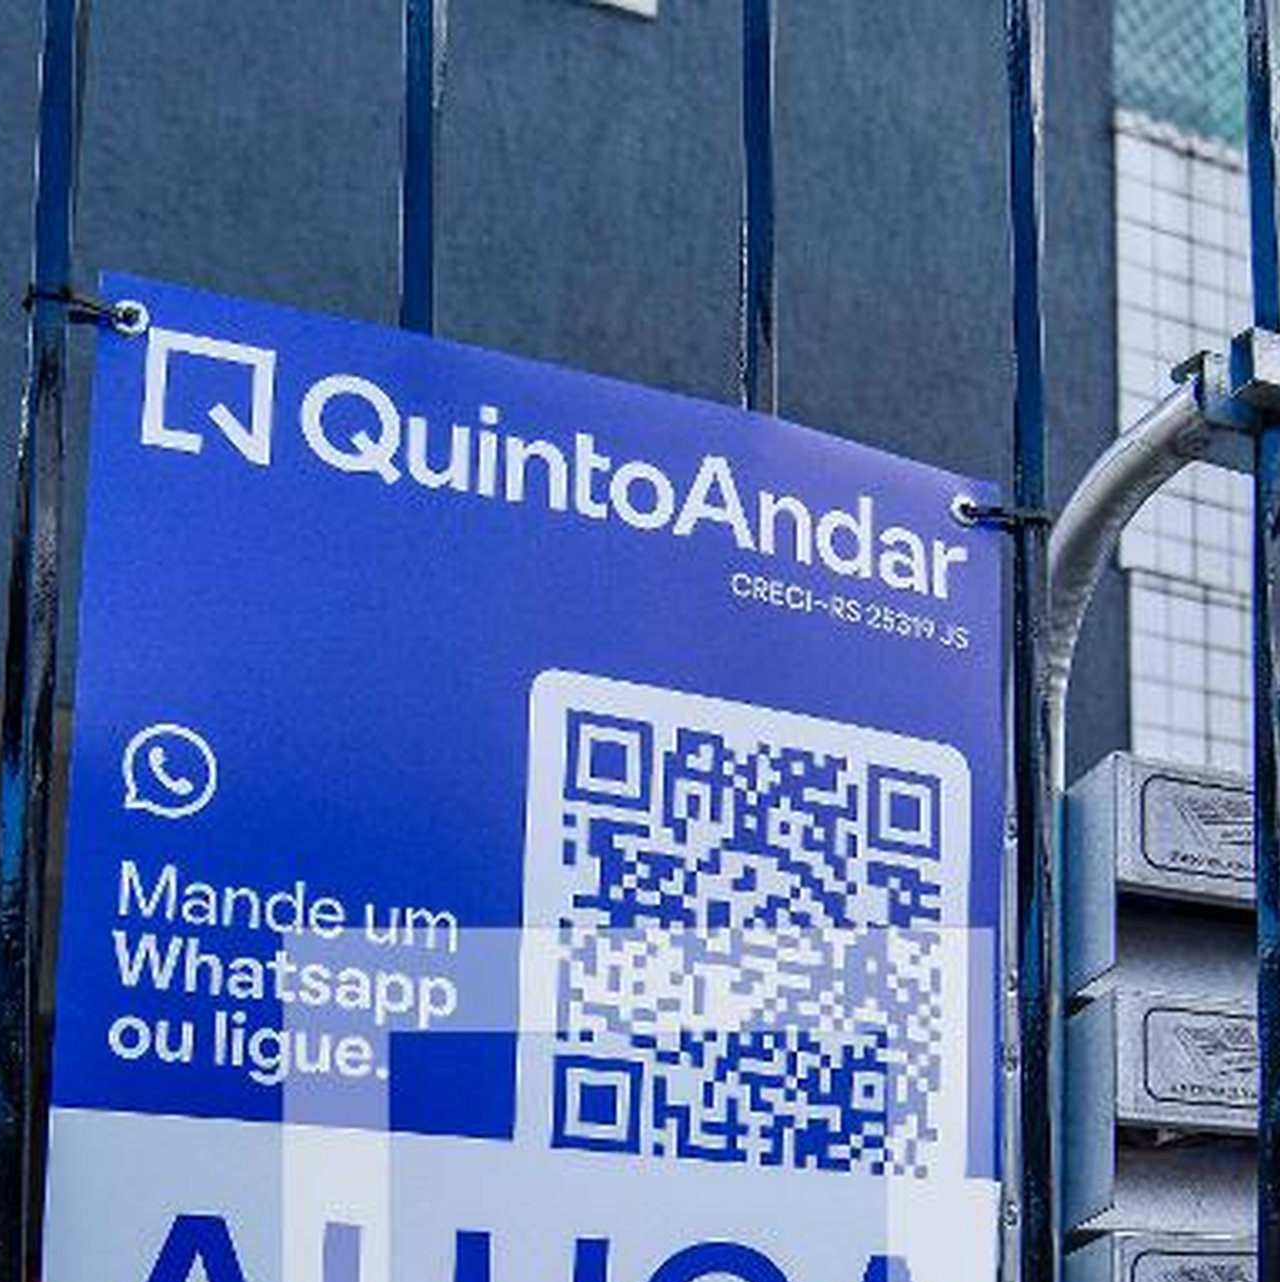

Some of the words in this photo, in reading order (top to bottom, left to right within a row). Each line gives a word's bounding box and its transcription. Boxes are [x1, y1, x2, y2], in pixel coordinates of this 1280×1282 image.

[300, 374, 967, 599] QuintoAndar
[117, 859, 345, 938] Mande
[364, 902, 458, 953] um
[112, 930, 458, 1029] Whatsapp
[108, 1015, 194, 1063] ou
[214, 1010, 390, 1085] ligue.
